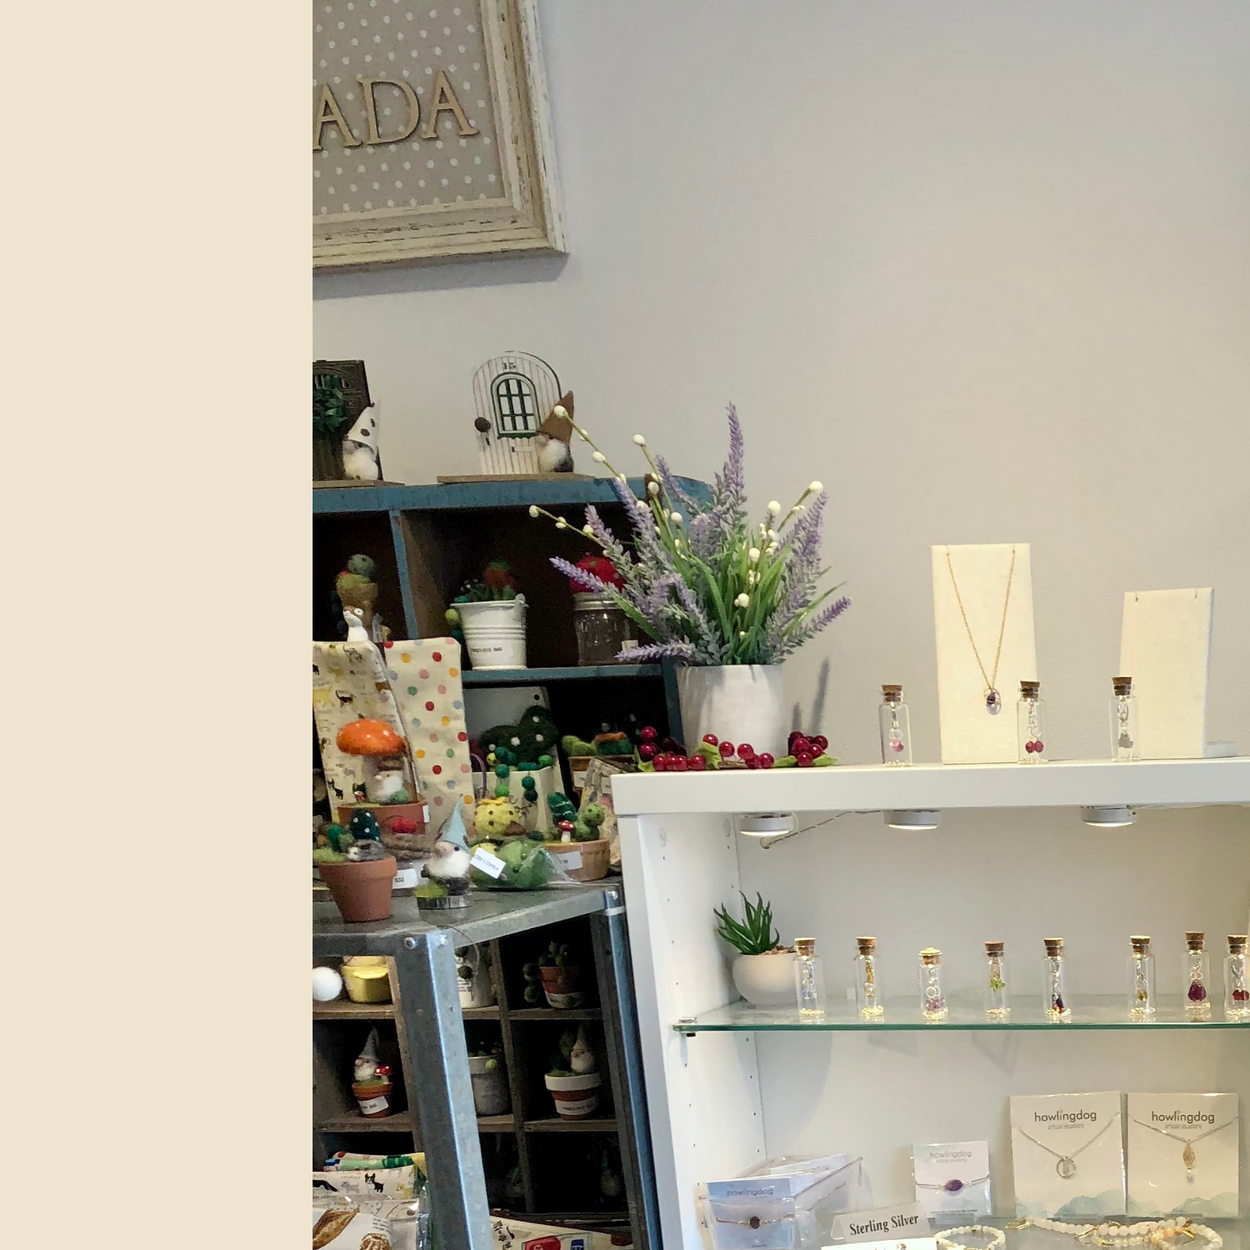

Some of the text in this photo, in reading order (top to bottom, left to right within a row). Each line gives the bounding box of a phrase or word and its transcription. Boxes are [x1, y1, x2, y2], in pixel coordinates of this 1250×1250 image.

[1034, 1111, 1097, 1123] howlingdog
[1151, 1111, 1215, 1124] howlingdog
[930, 1150, 972, 1160] howlingdog
[727, 1187, 774, 1197] howlingdog
[849, 1213, 919, 1236] Sterling Silver
